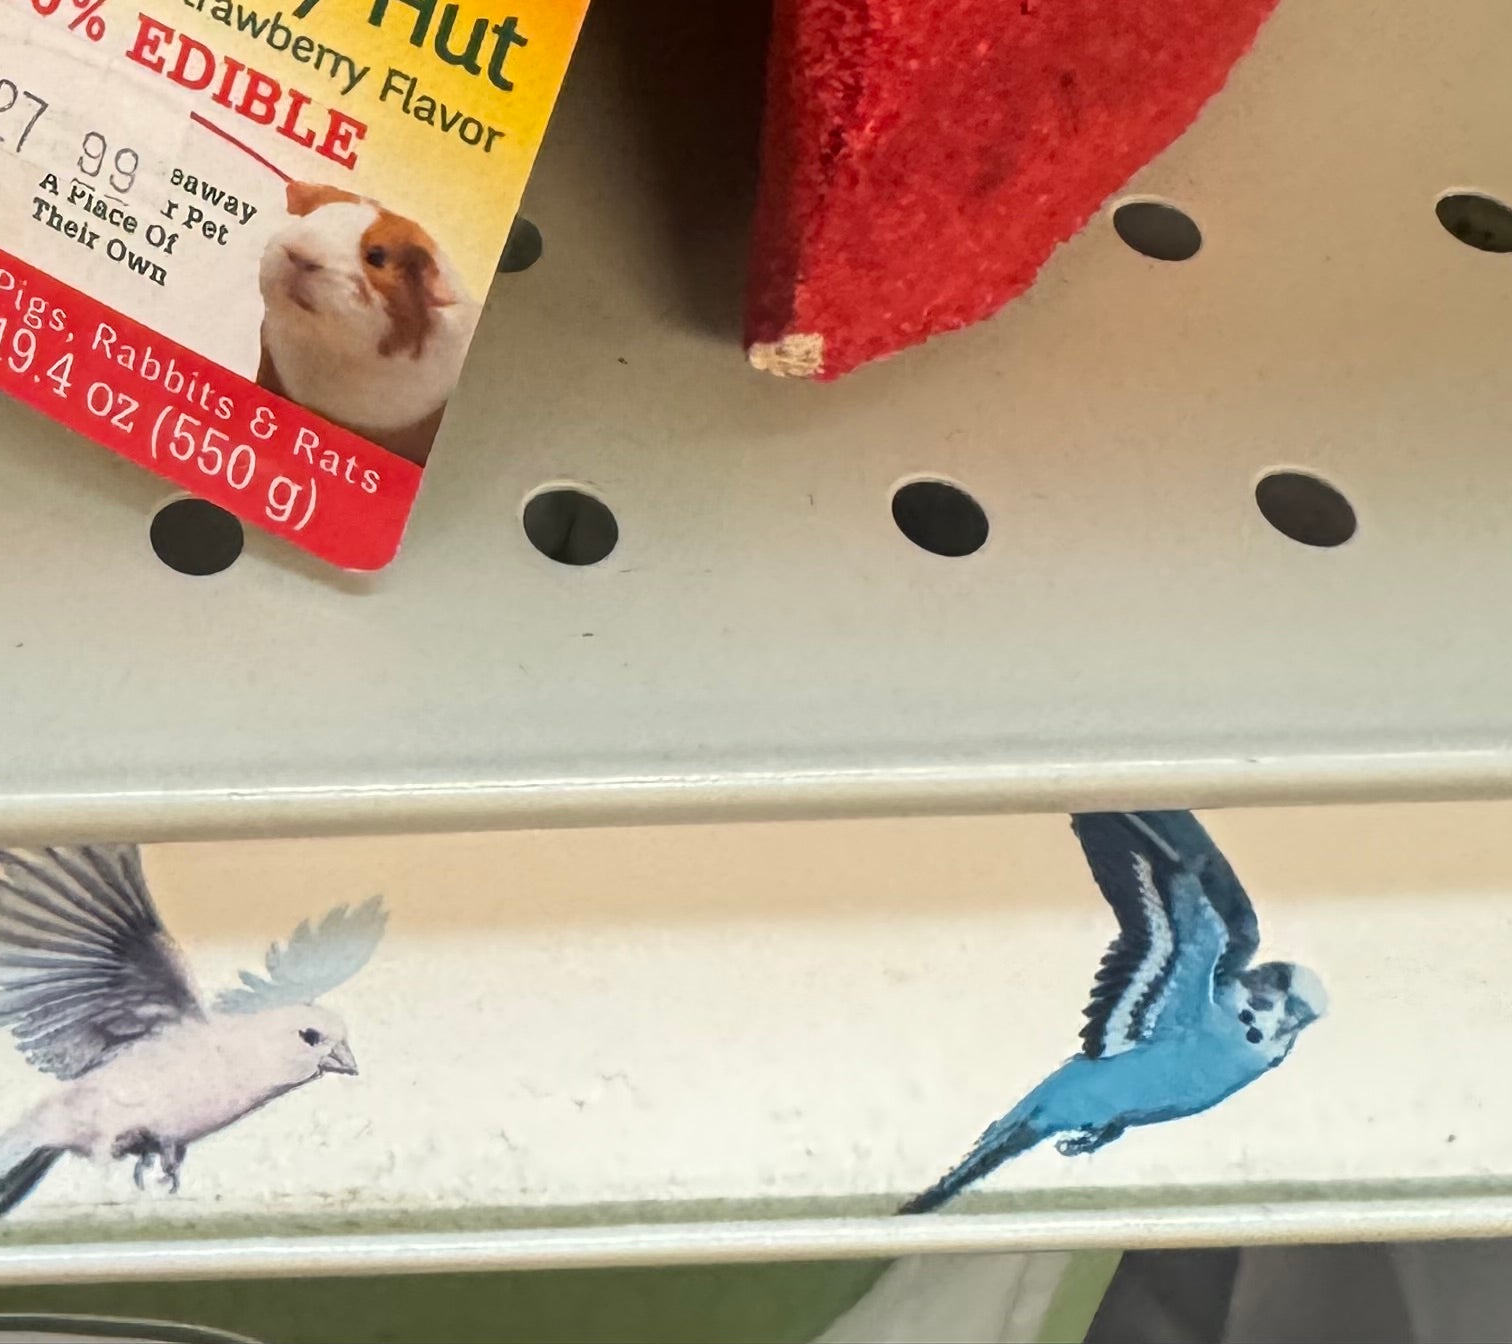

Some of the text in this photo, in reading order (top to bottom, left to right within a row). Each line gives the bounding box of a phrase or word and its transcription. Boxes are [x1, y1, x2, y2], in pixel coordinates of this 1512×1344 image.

[125, 13, 368, 170] EDIBLE
[379, 67, 505, 153] Flavor
[77, 131, 139, 194] 99
[33, 197, 168, 286] Their Own
[39, 173, 179, 255] A Place Of
[182, 205, 230, 246] Pet
[92, 322, 234, 420] Rabbits
[249, 406, 278, 440] &
[293, 427, 381, 494] Rats
[87, 381, 139, 433] oz
[151, 405, 257, 490] (550
[265, 476, 317, 531] g)
